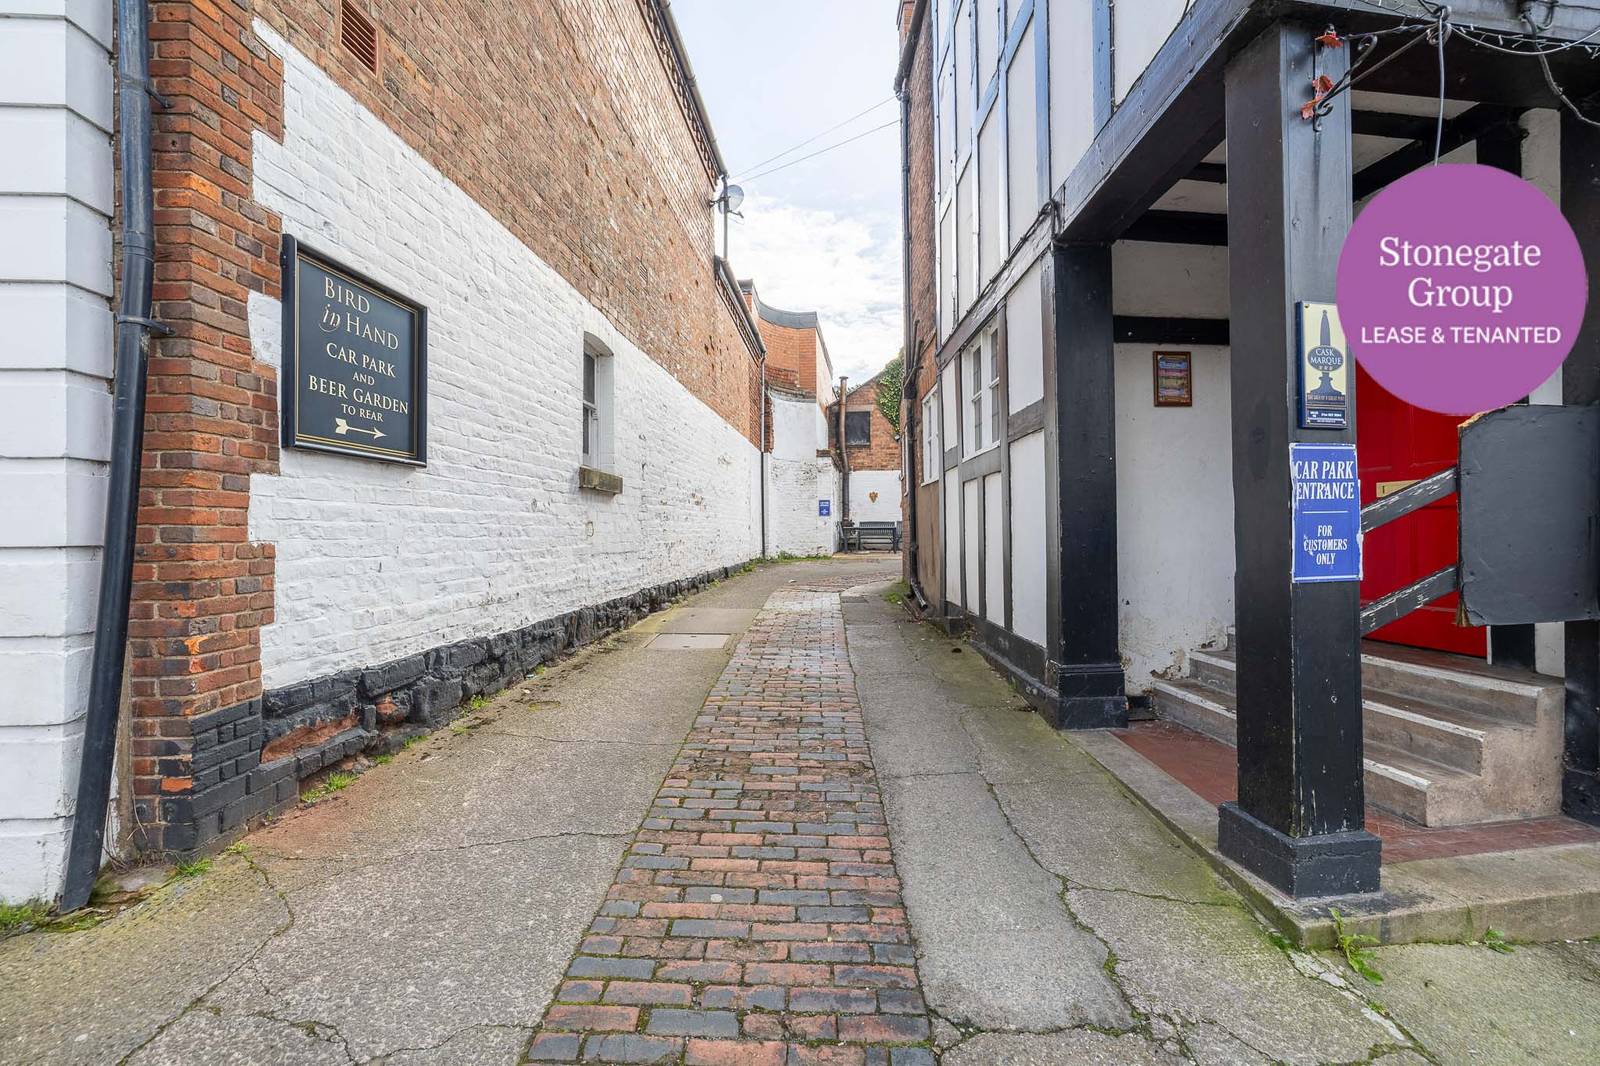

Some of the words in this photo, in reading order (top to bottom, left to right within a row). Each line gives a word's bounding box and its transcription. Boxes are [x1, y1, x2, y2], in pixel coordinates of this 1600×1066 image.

[324, 276, 370, 314] BIRD
[318, 303, 341, 332] in
[346, 312, 399, 350] HAND
[326, 342, 359, 366] CAR
[362, 353, 396, 378] PARK
[1310, 356, 1342, 365] MARQUE
[1315, 348, 1335, 357] CASK
[352, 371, 375, 386] AND
[308, 374, 348, 400] BEER
[353, 388, 409, 415] GARDEN
[341, 403, 356, 416] TO
[359, 409, 384, 422] REAR
[1295, 460, 1319, 479] CAR
[1322, 460, 1354, 479] PARK
[1296, 482, 1355, 500] ENTRANCE
[1317, 525, 1333, 537] FOR
[1303, 538, 1348, 551] CUSTOMERS
[1316, 552, 1336, 565] ONLY
